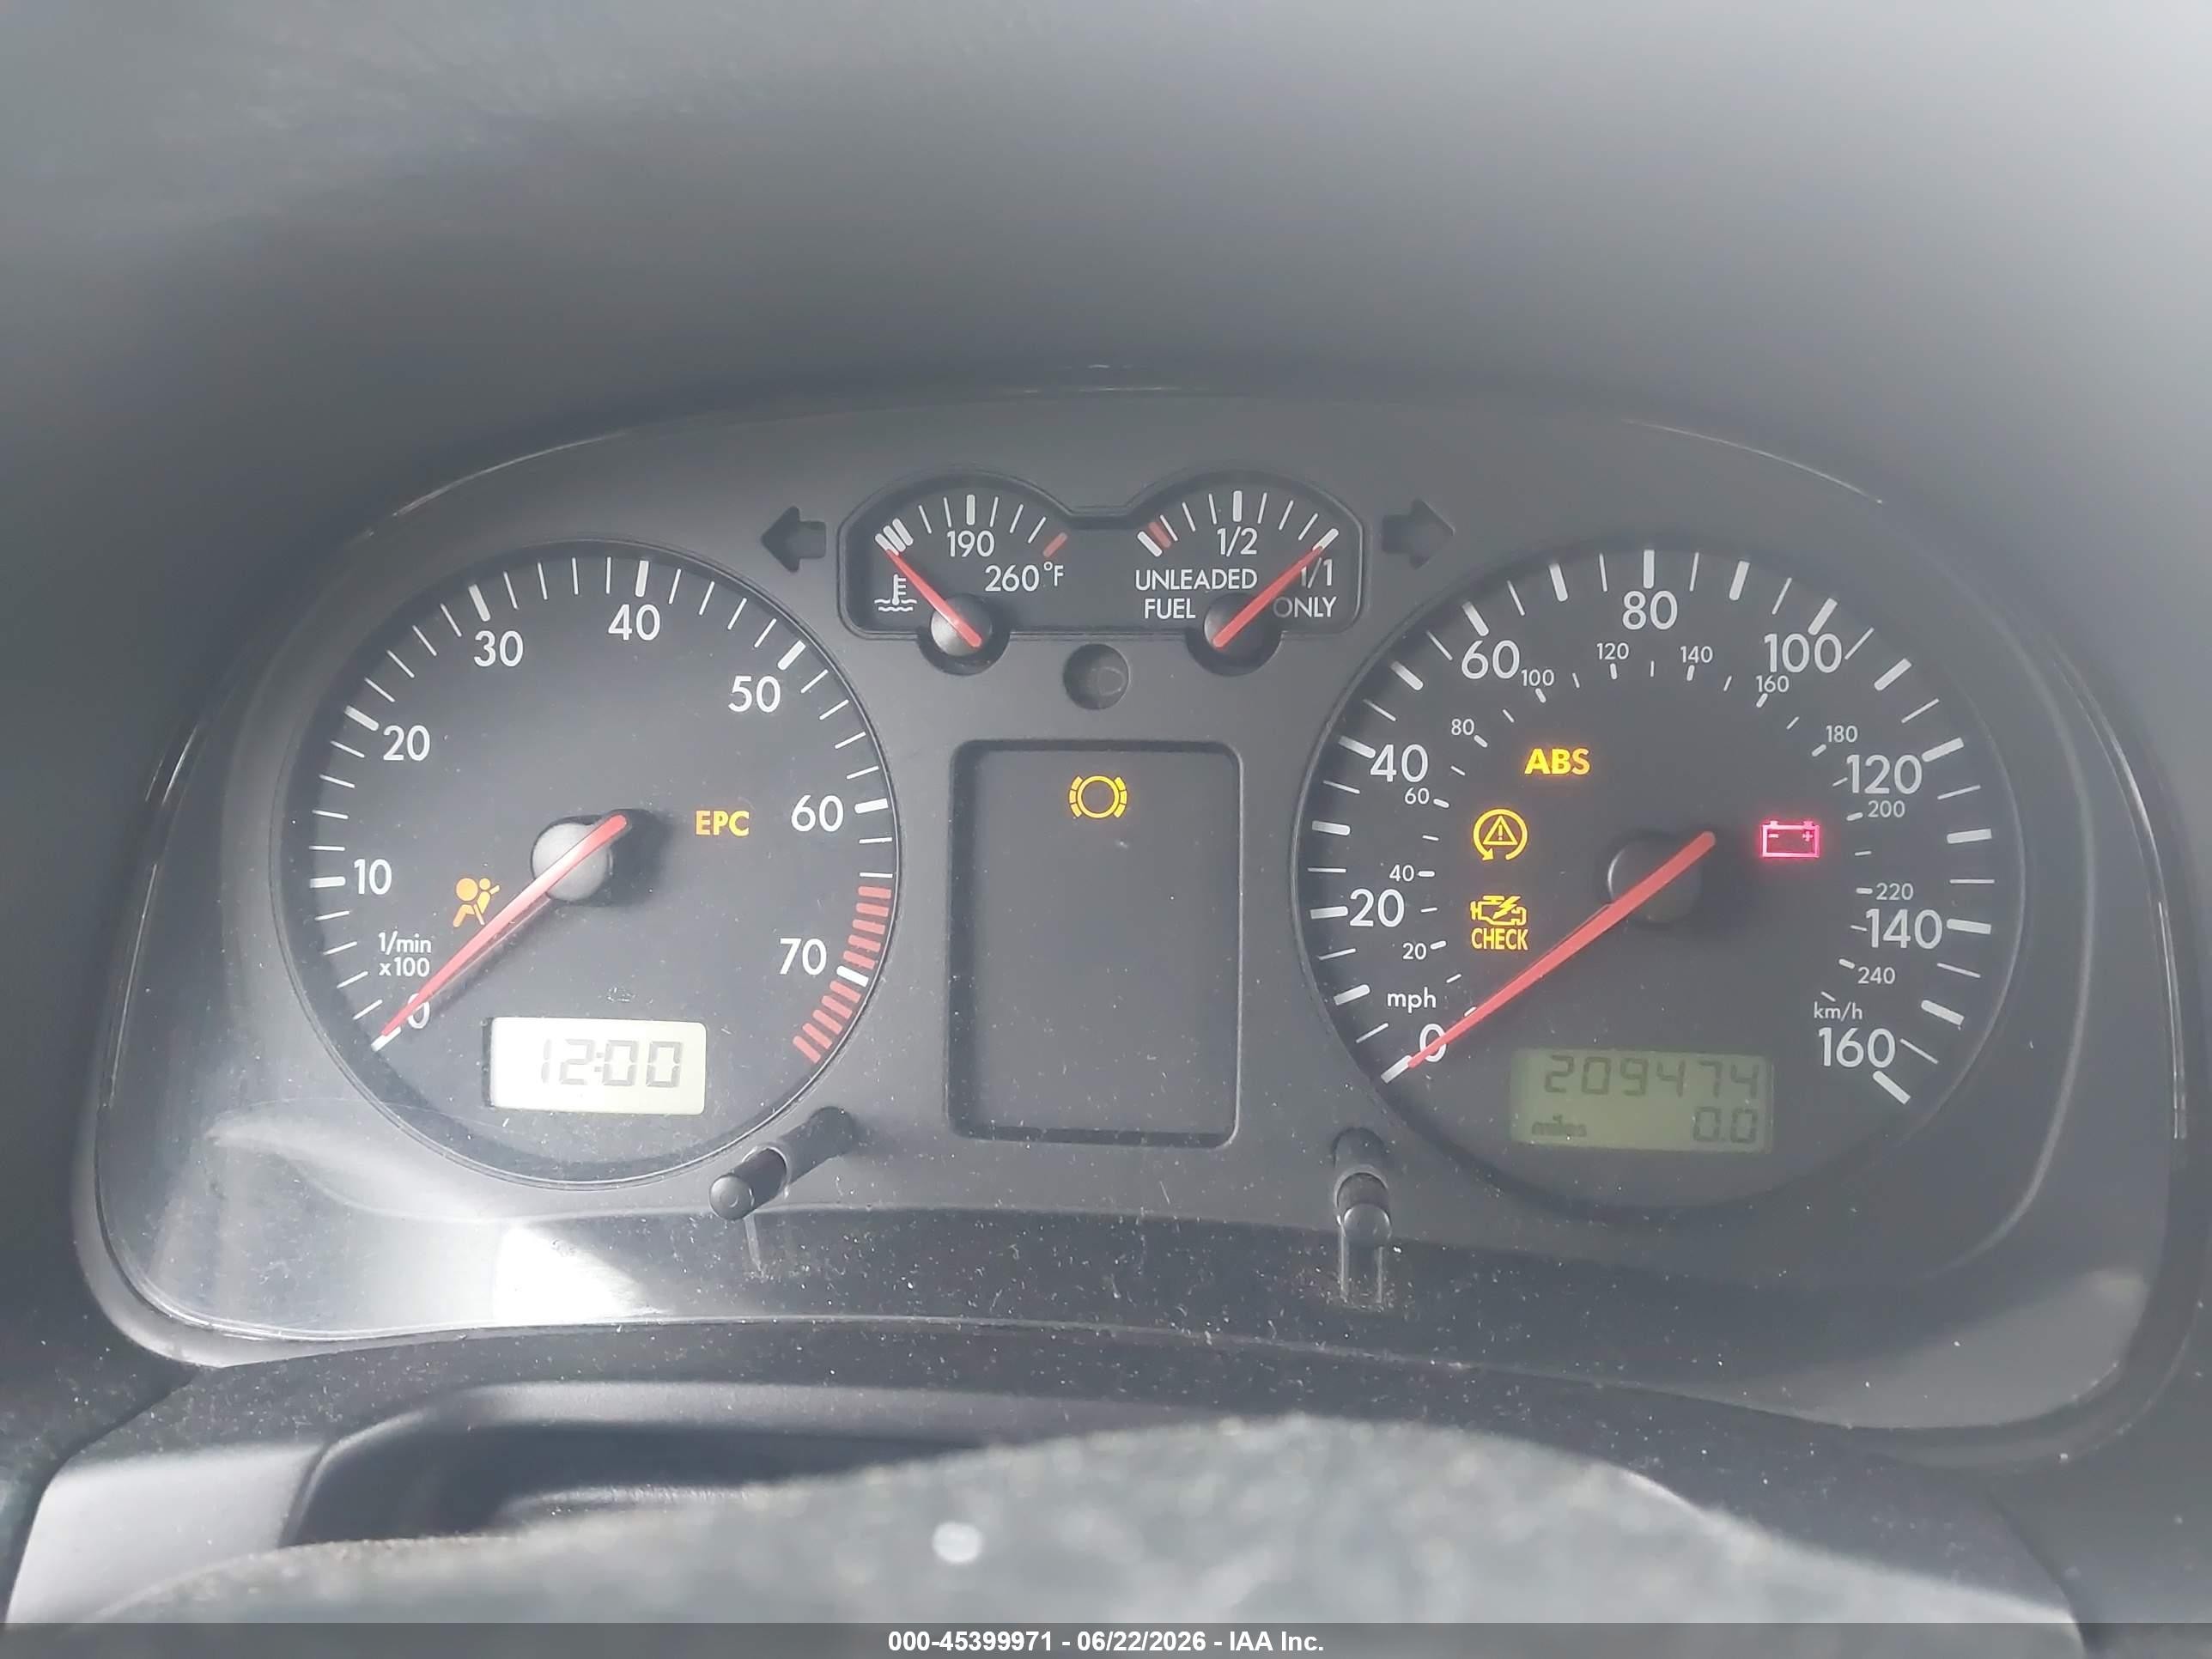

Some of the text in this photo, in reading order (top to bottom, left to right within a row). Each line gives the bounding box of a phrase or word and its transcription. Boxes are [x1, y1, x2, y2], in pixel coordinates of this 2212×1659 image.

[946, 531, 995, 556] 190
[1217, 527, 1258, 556] 1/2
[1135, 568, 1258, 591] UNLEADED
[1144, 596, 1337, 620] FUEL ONLY
[1622, 590, 1678, 630] 80
[607, 605, 661, 641] 40
[473, 630, 524, 667] 30
[1461, 640, 1520, 679] 60
[1596, 642, 1630, 660] 120
[1680, 646, 1714, 664] 140
[1763, 633, 1842, 673] 100
[1521, 669, 1555, 687] 100
[1755, 675, 1790, 693] 160
[727, 676, 781, 713] 50
[1450, 718, 1475, 736] 80
[1825, 726, 1859, 744] 180
[382, 725, 431, 762] 20
[1370, 744, 1429, 783] 40
[1524, 748, 1591, 775] ABS
[1845, 754, 1923, 795] 120
[1404, 787, 1430, 805] 60
[1867, 800, 1905, 818] 200
[695, 810, 750, 836] EPC
[791, 795, 843, 832] 60
[353, 859, 392, 895] 10
[1389, 865, 1415, 882] 40
[1875, 883, 1914, 901] 220
[1349, 889, 1405, 928] 20
[1471, 927, 1528, 951] CHECK
[1865, 908, 1942, 950] 140
[378, 932, 432, 955] 1/min
[779, 938, 828, 975] 70
[1402, 944, 1427, 960] 20
[378, 957, 430, 978] x100
[1857, 967, 1896, 985] 240
[1387, 988, 1437, 1013] mph
[1814, 1001, 1863, 1021] km/h
[1419, 1023, 1448, 1063] 0
[1818, 1027, 1896, 1070] 160
[540, 1038, 683, 1089] 12:00
[1544, 1054, 1759, 1099] 209474
